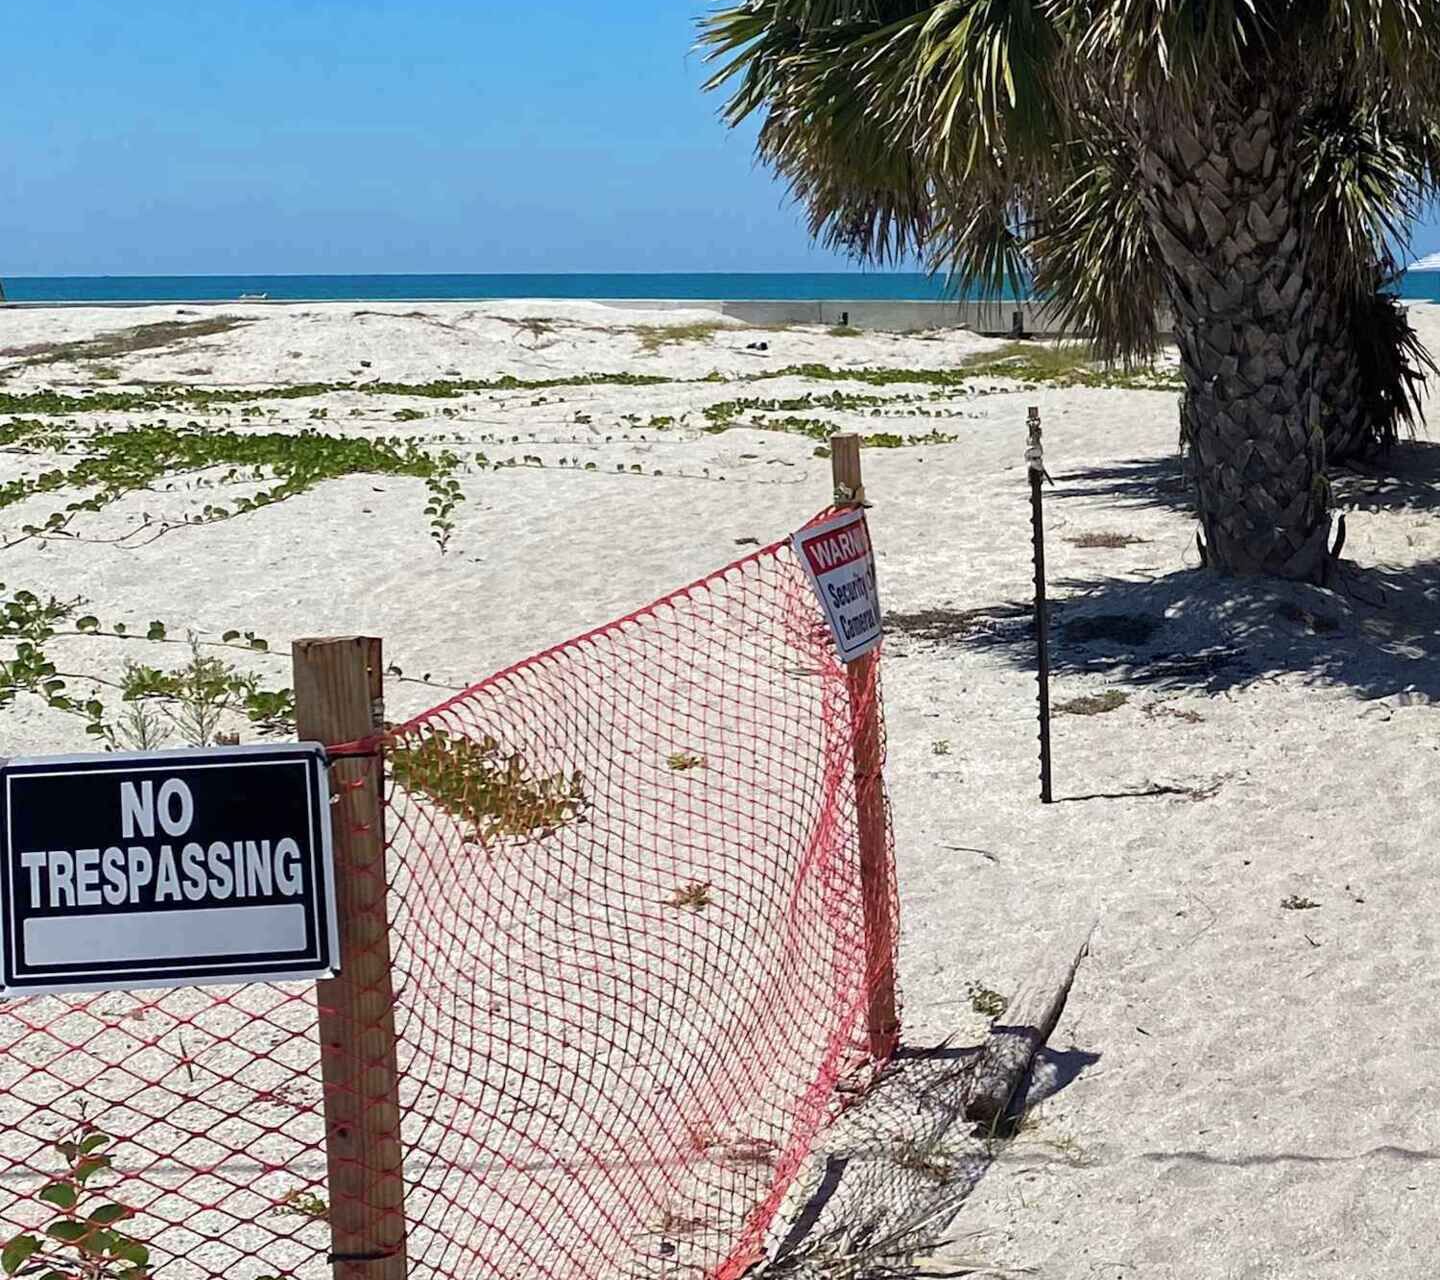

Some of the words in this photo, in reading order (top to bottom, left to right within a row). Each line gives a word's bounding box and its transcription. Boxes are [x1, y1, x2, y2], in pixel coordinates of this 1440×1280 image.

[827, 572, 869, 609] Security
[120, 777, 195, 839] NO
[20, 836, 304, 909] TRESPASSING
